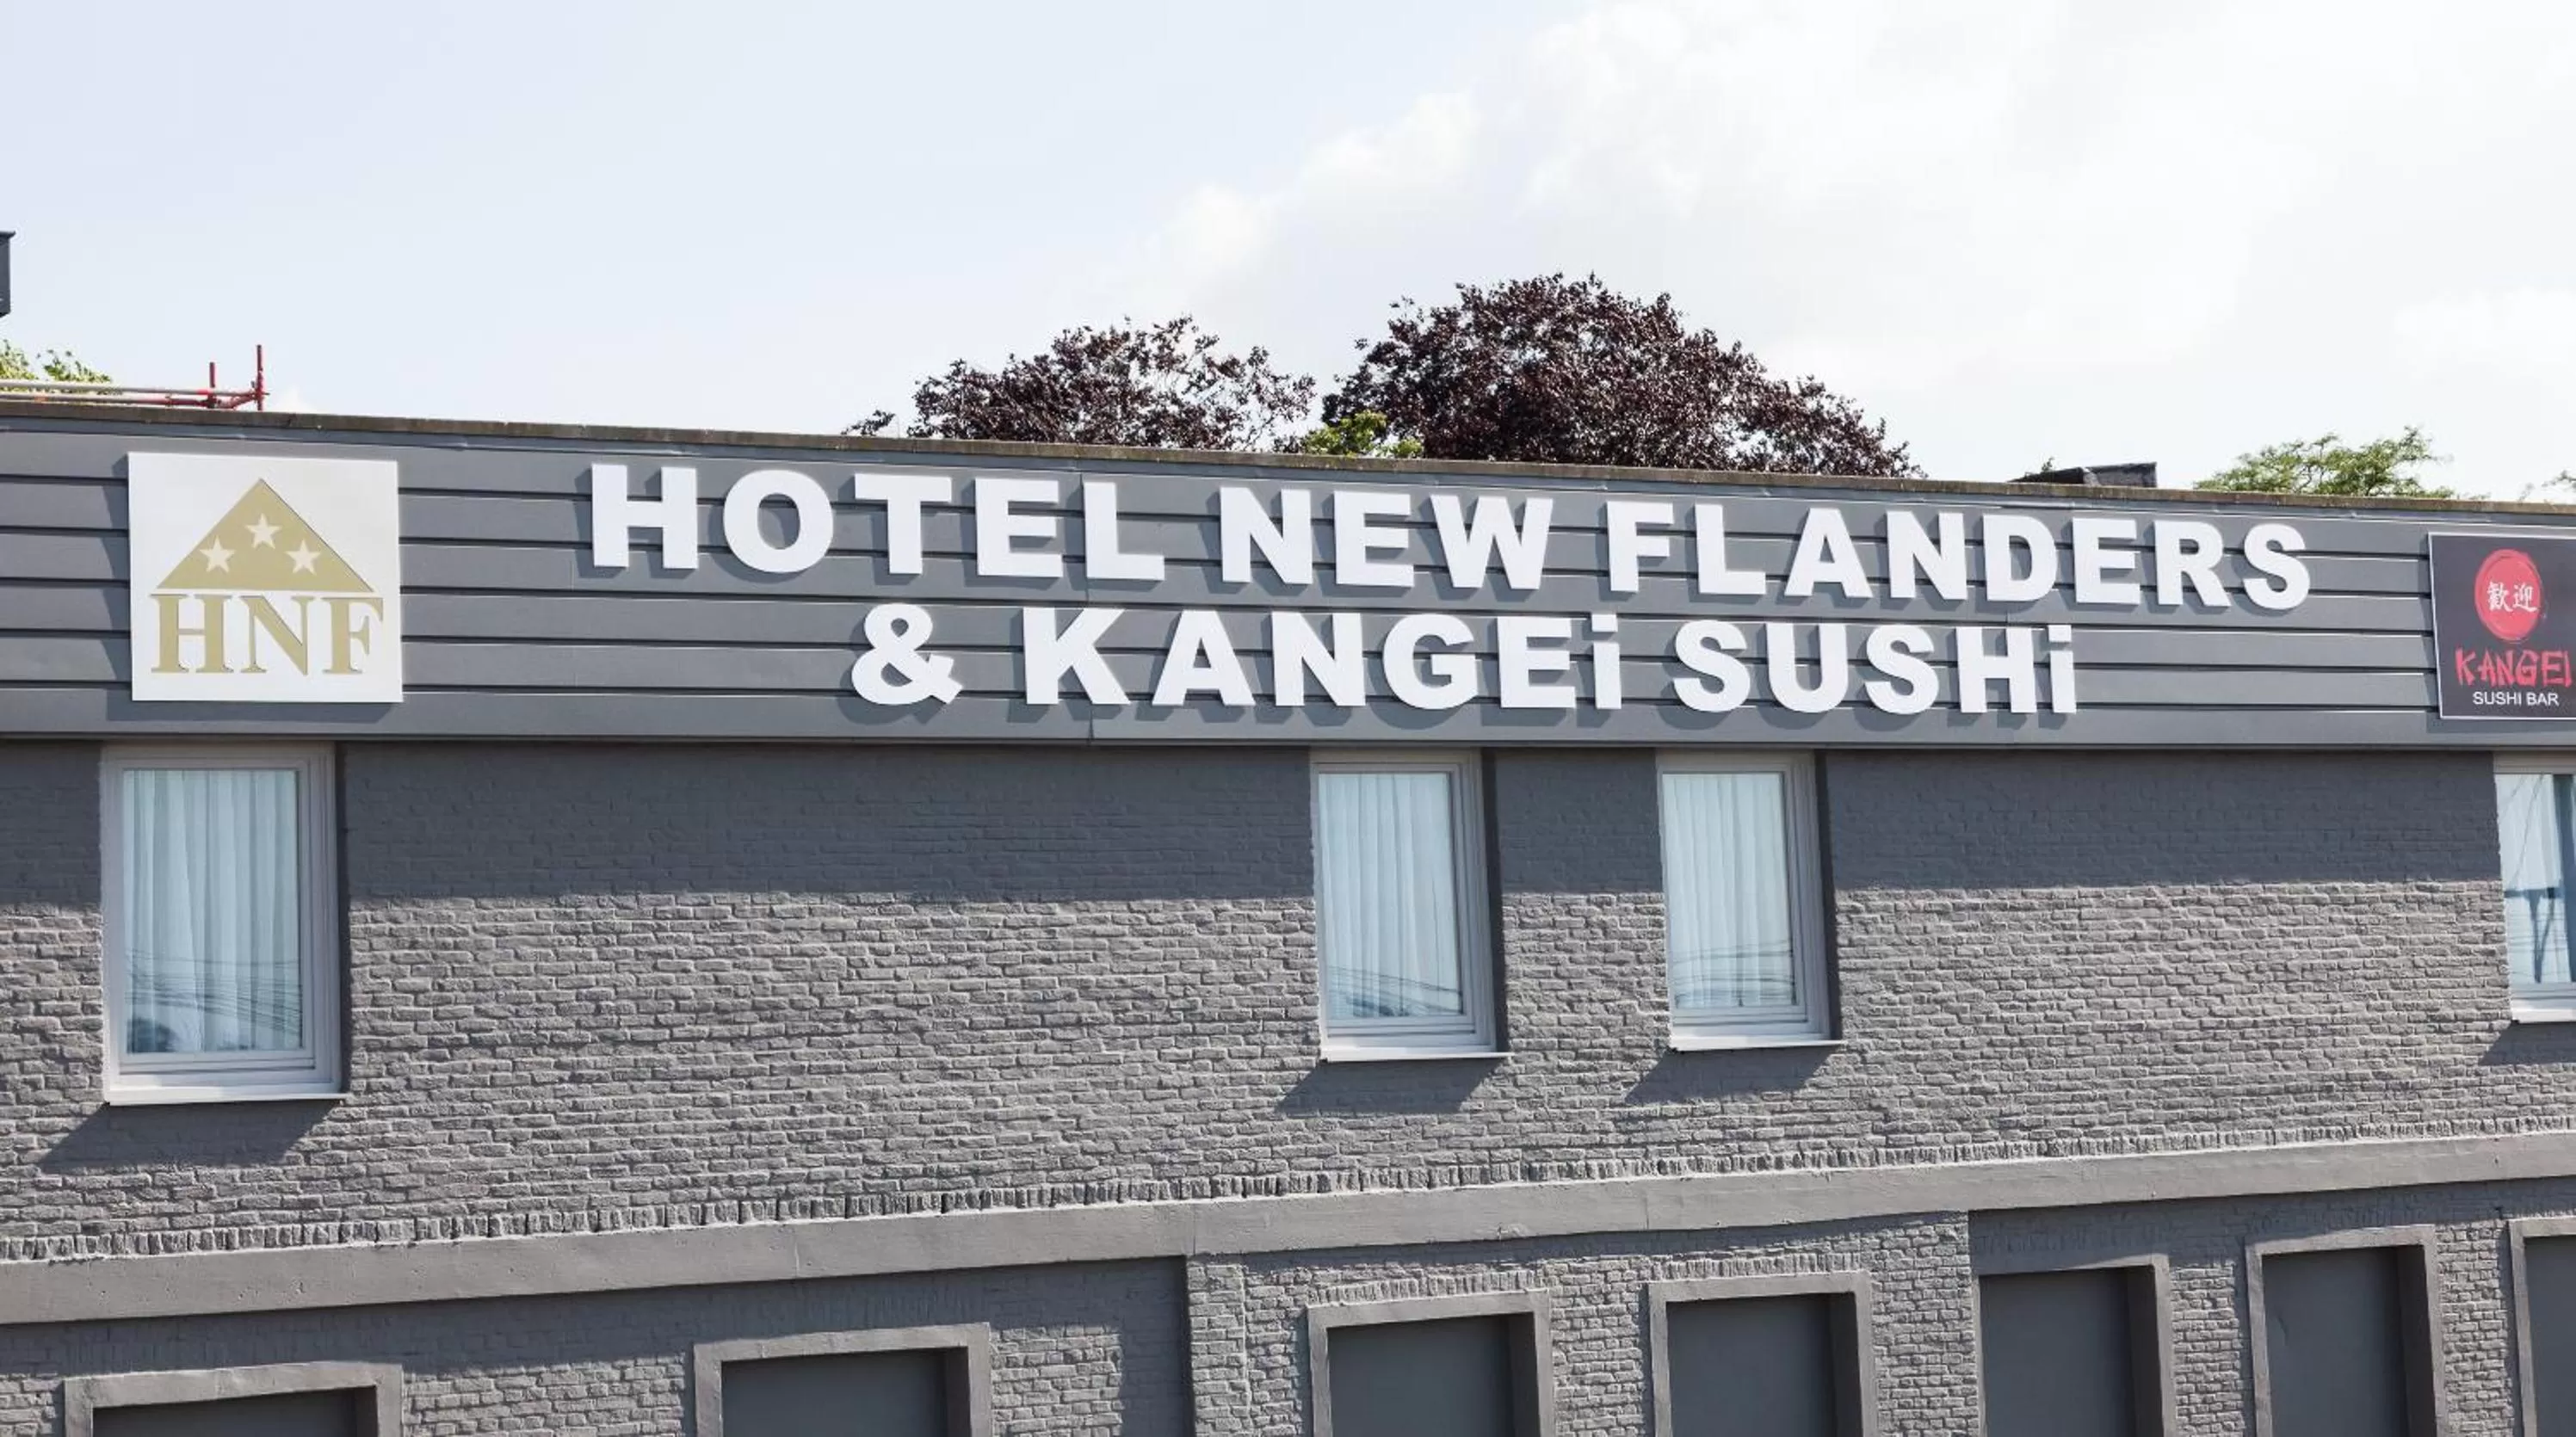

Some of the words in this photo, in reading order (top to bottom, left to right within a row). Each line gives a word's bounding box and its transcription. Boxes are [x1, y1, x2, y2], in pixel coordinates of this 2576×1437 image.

[590, 463, 1166, 581] HOTEL
[1219, 486, 1554, 589] NEW
[1606, 500, 2311, 609] FLANDERS
[149, 594, 384, 675] HNF
[850, 603, 963, 706] &
[2456, 648, 2572, 688] KANGEI
[2473, 691, 2522, 706] SUSHI
[2526, 692, 2560, 706] BAR
